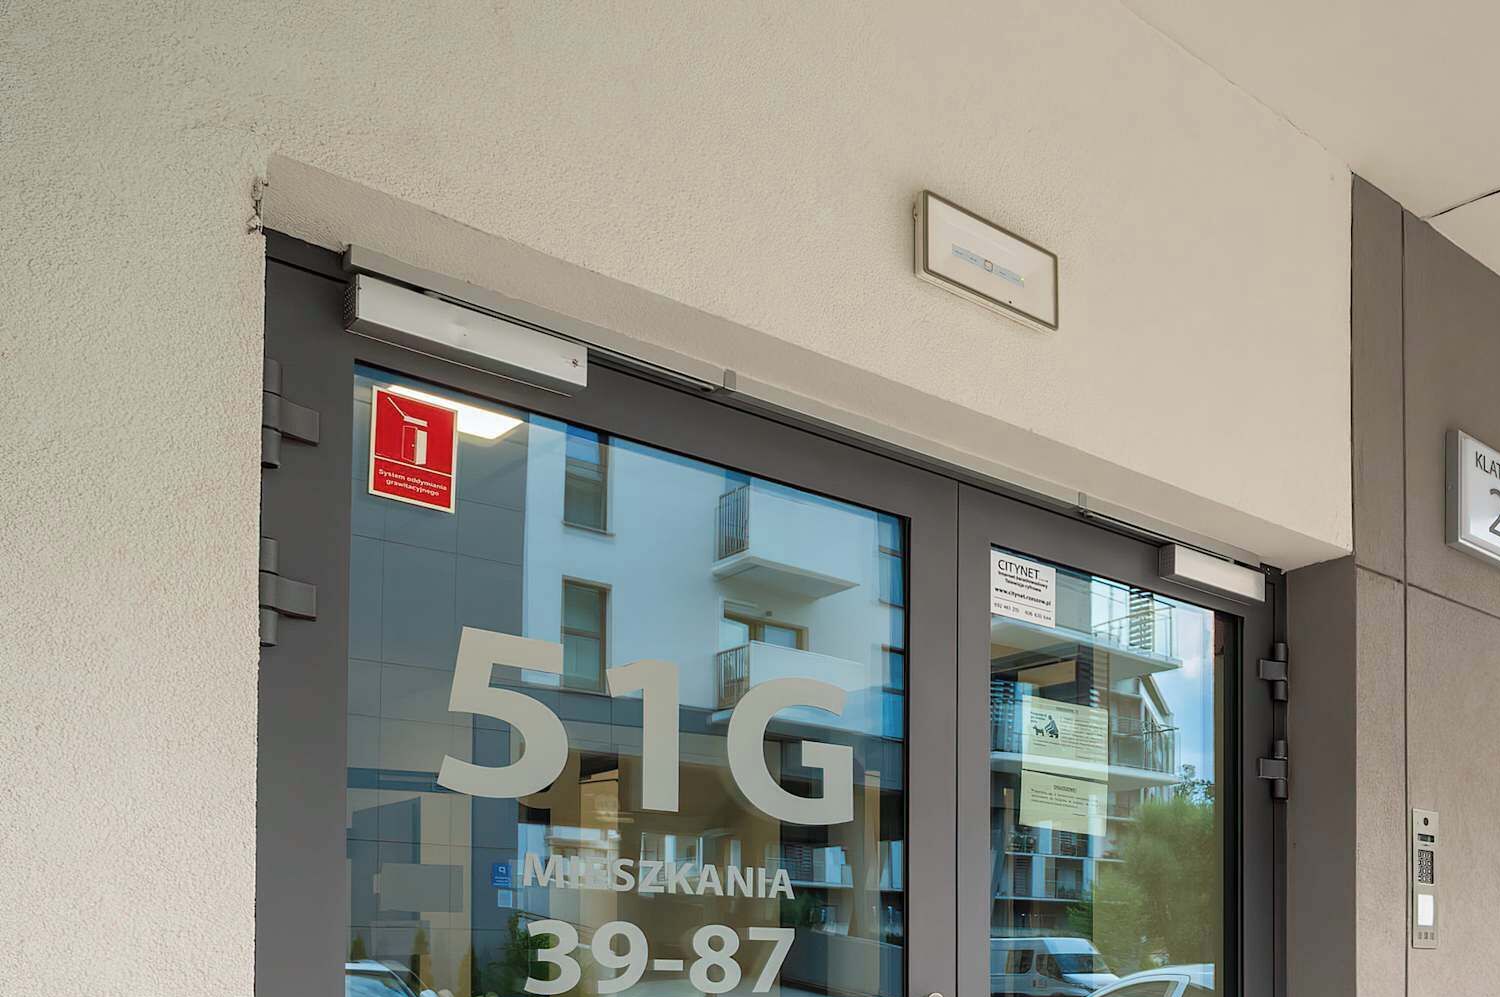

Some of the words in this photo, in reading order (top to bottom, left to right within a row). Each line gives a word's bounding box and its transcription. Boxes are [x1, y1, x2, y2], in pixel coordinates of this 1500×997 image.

[998, 559, 1040, 580] CITYNET
[436, 625, 854, 826] 51G
[522, 852, 796, 900] MIESZKANIA
[523, 920, 797, 996] 39-87
